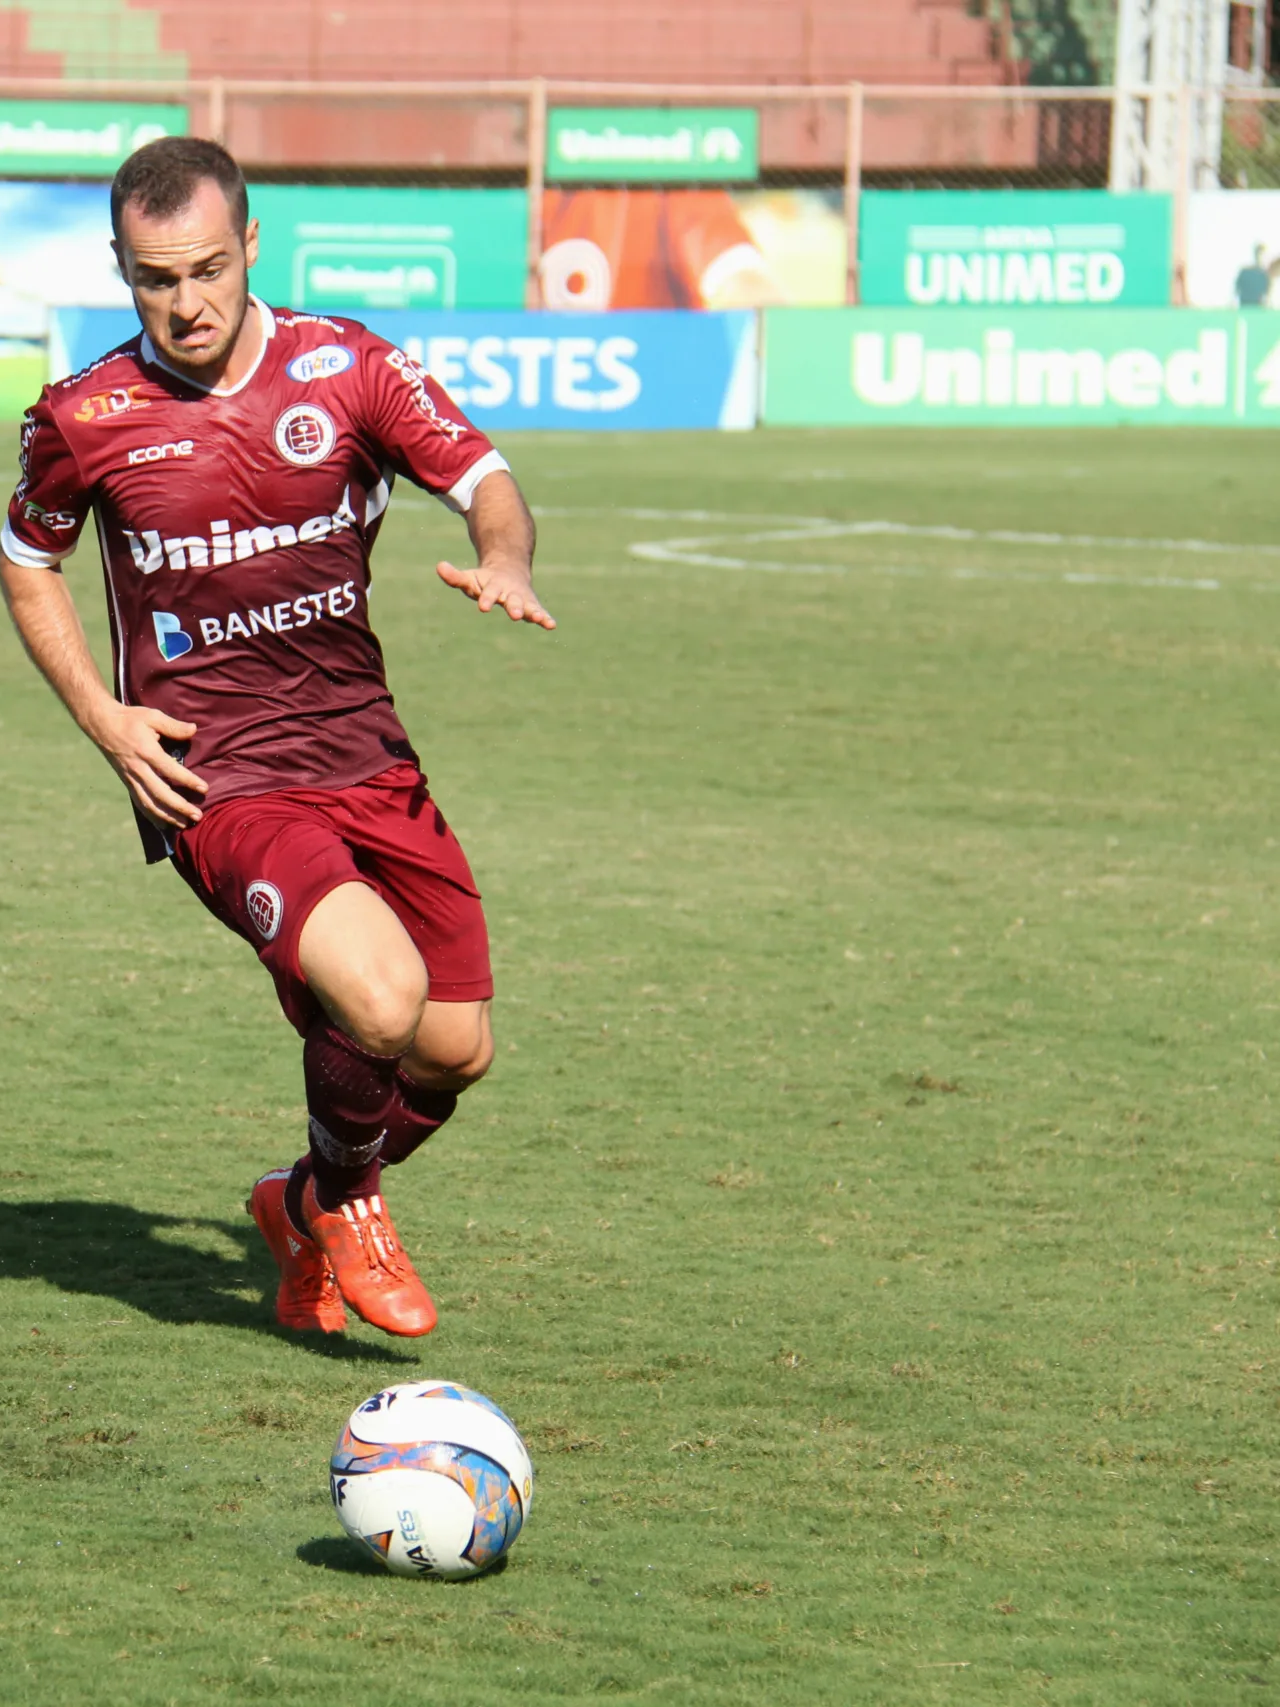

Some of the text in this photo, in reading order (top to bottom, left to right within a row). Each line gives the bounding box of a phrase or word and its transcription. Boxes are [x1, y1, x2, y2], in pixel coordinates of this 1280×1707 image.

[906, 252, 1124, 303] UNIMED
[852, 329, 1228, 408] Unimed
[199, 581, 357, 645] BANESTES
